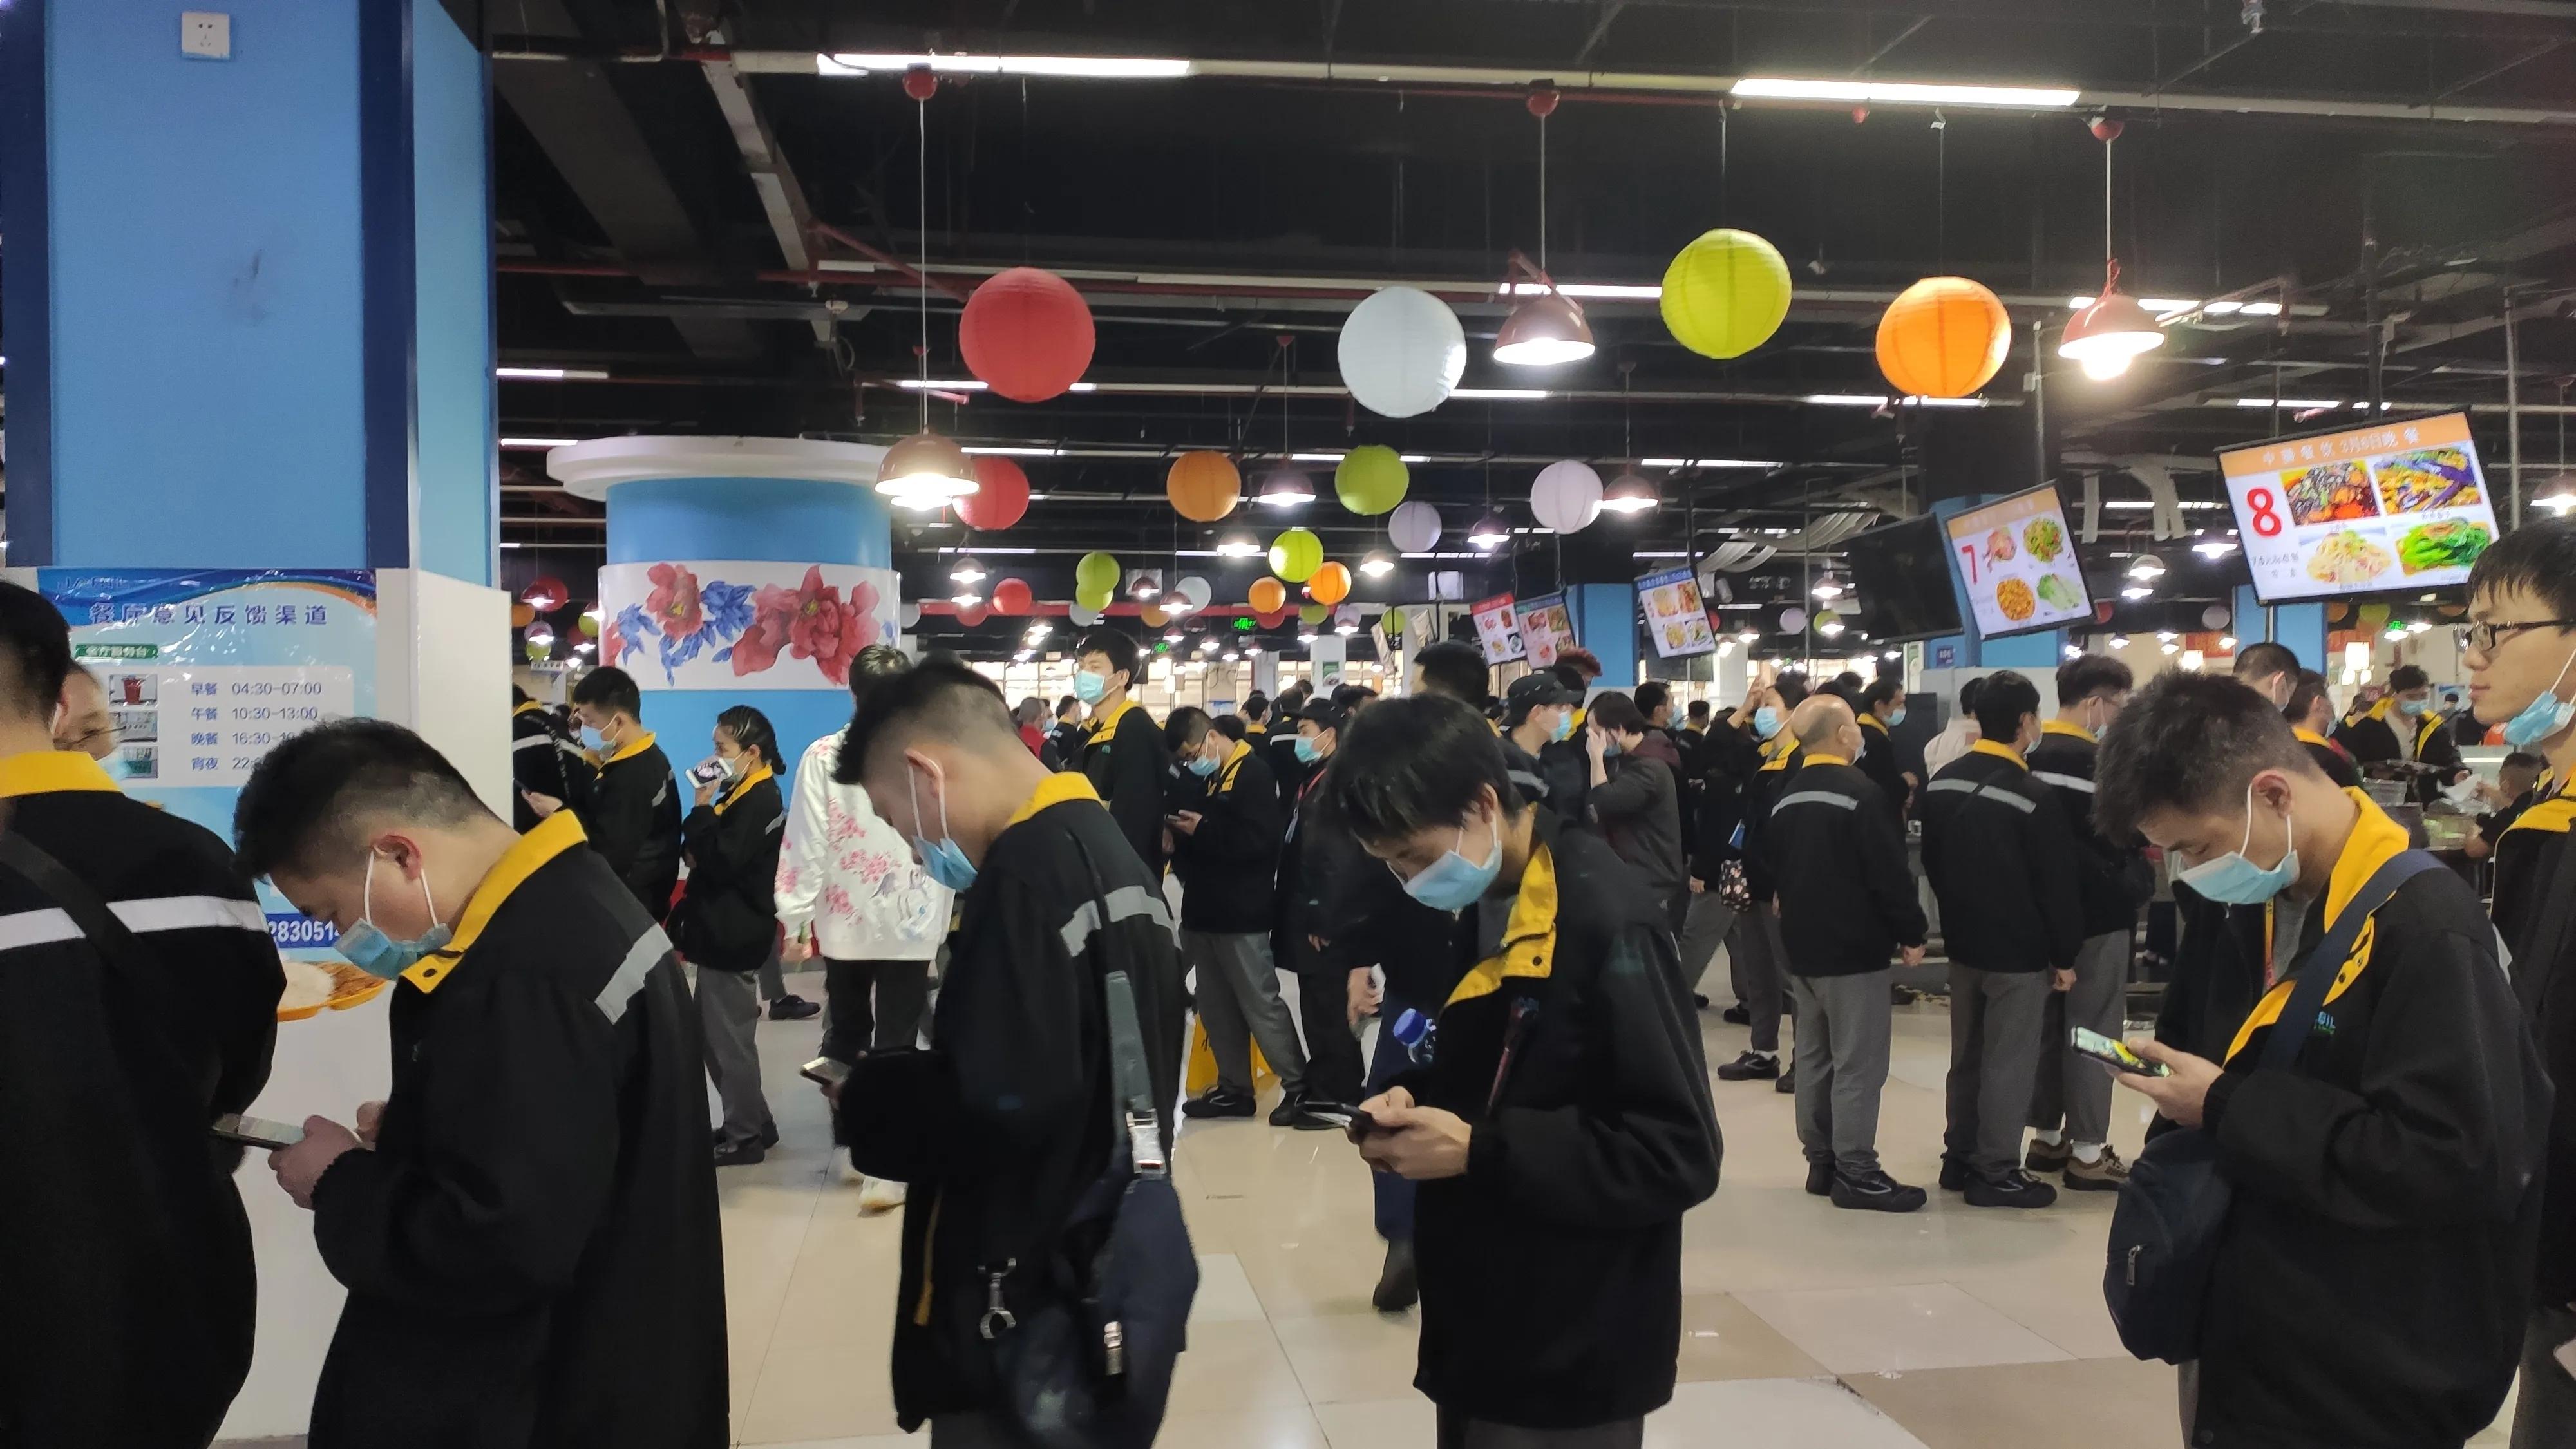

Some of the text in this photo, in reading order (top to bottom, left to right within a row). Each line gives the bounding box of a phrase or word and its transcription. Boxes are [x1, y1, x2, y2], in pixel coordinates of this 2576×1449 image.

[2246, 488, 2282, 536] 8
[1961, 544, 1978, 586] 7
[89, 601, 328, 625] 餐厅意见反馈渠道
[191, 681, 322, 696] 早餐 04:30-07:00
[191, 706, 318, 721] 午餐 10:30-13:00
[191, 732, 218, 746] 晚餐
[268, 919, 340, 943] 283051
